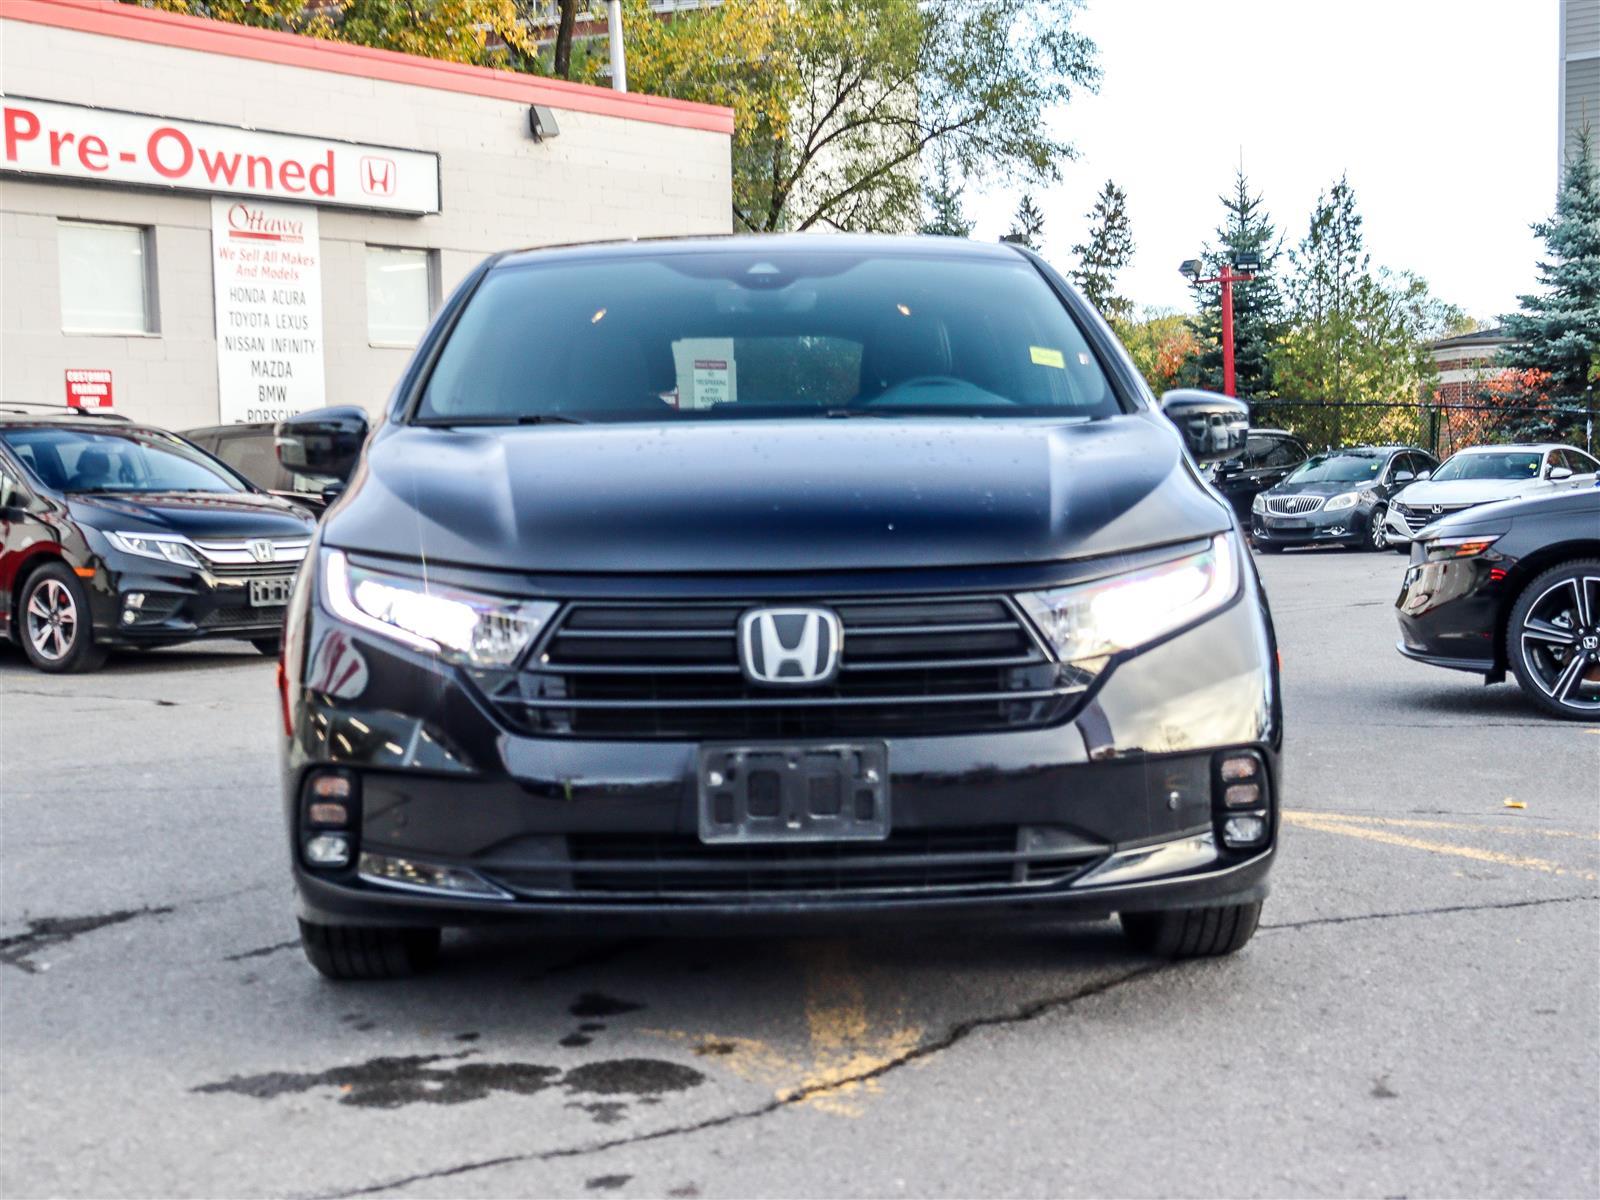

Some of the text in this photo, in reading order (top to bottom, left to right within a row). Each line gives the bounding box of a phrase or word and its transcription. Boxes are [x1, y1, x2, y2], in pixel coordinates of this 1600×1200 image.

[4, 107, 336, 197] Pre-Owned
[227, 202, 304, 234] Ottawa
[219, 247, 316, 267] We Sell All Makes
[236, 263, 300, 281] And Models
[229, 286, 307, 306] HONDA ACURA
[229, 311, 309, 331] TOYOTA LEXUS
[224, 335, 317, 354] NISSAN INFINITY
[250, 360, 293, 379] MAZDA
[258, 384, 288, 403] BMW
